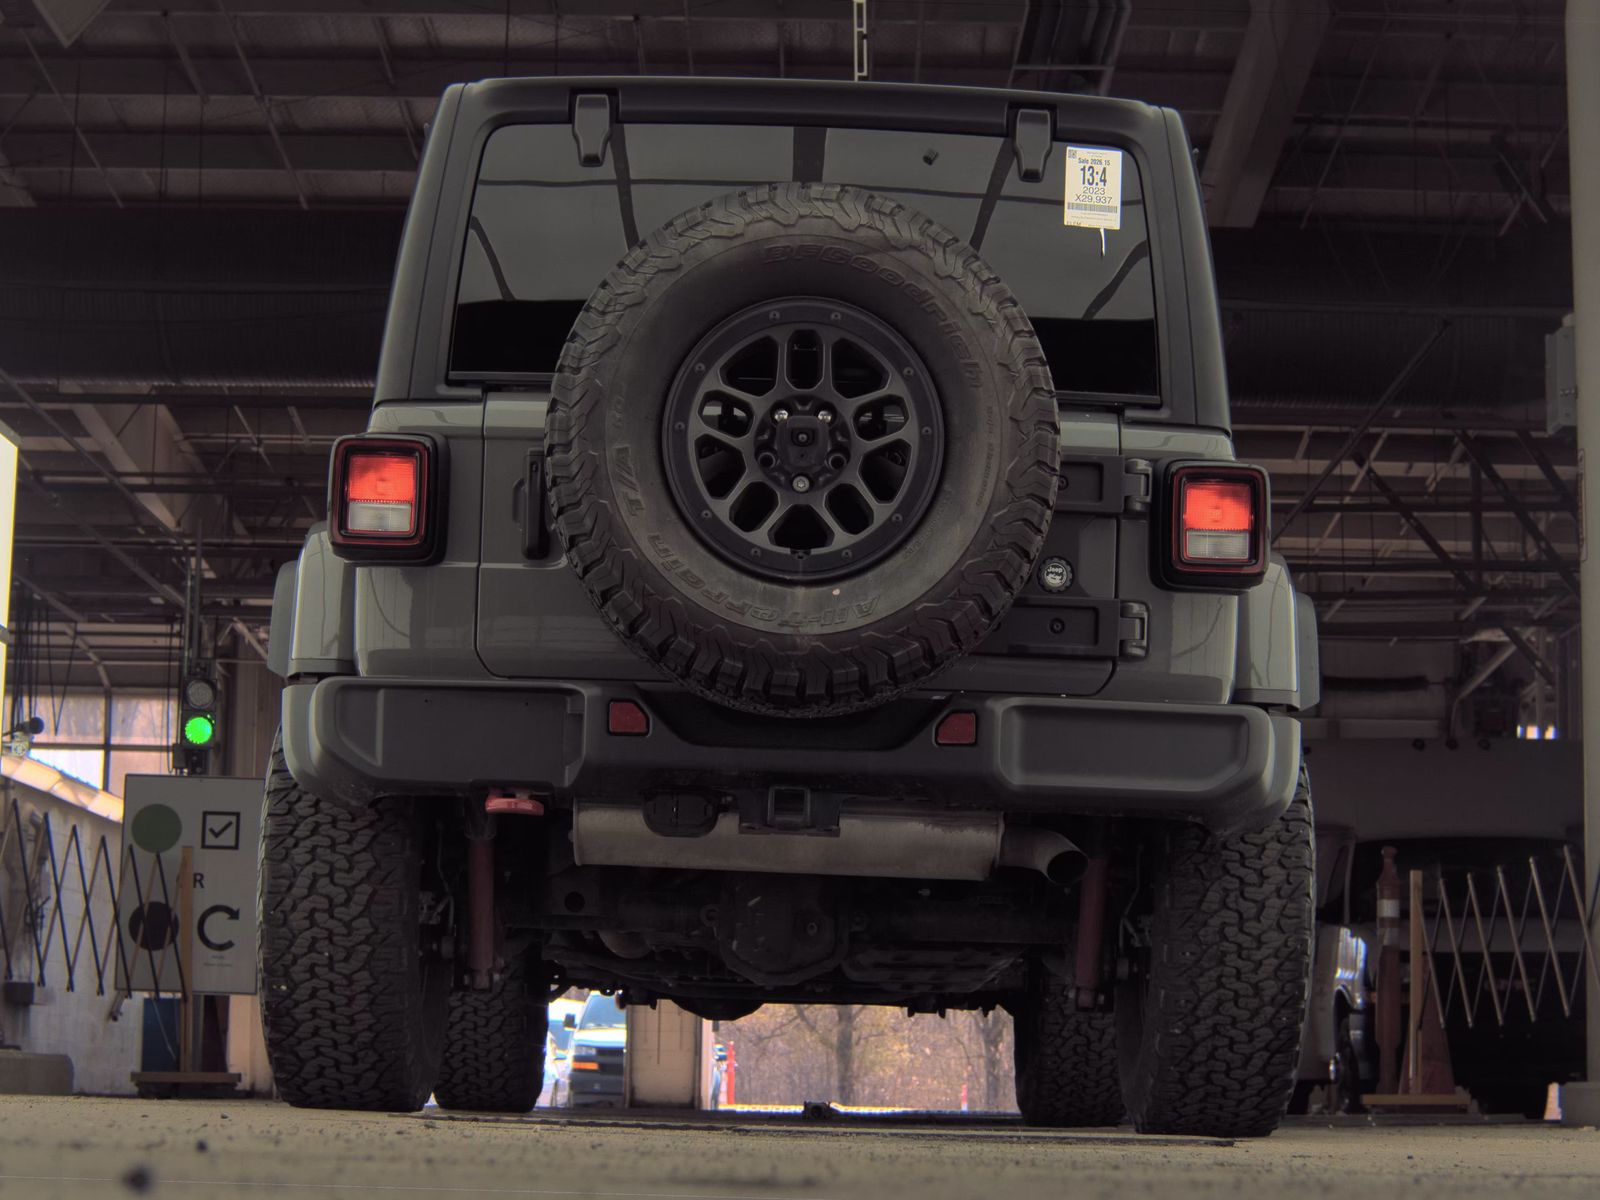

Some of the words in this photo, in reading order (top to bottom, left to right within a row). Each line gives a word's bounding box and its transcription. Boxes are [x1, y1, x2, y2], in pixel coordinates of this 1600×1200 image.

[1078, 157, 1089, 165] Sale
[1080, 165, 1107, 187] 13:4
[1082, 186, 1106, 196] 2023
[762, 244, 983, 388] BFGoodrich
